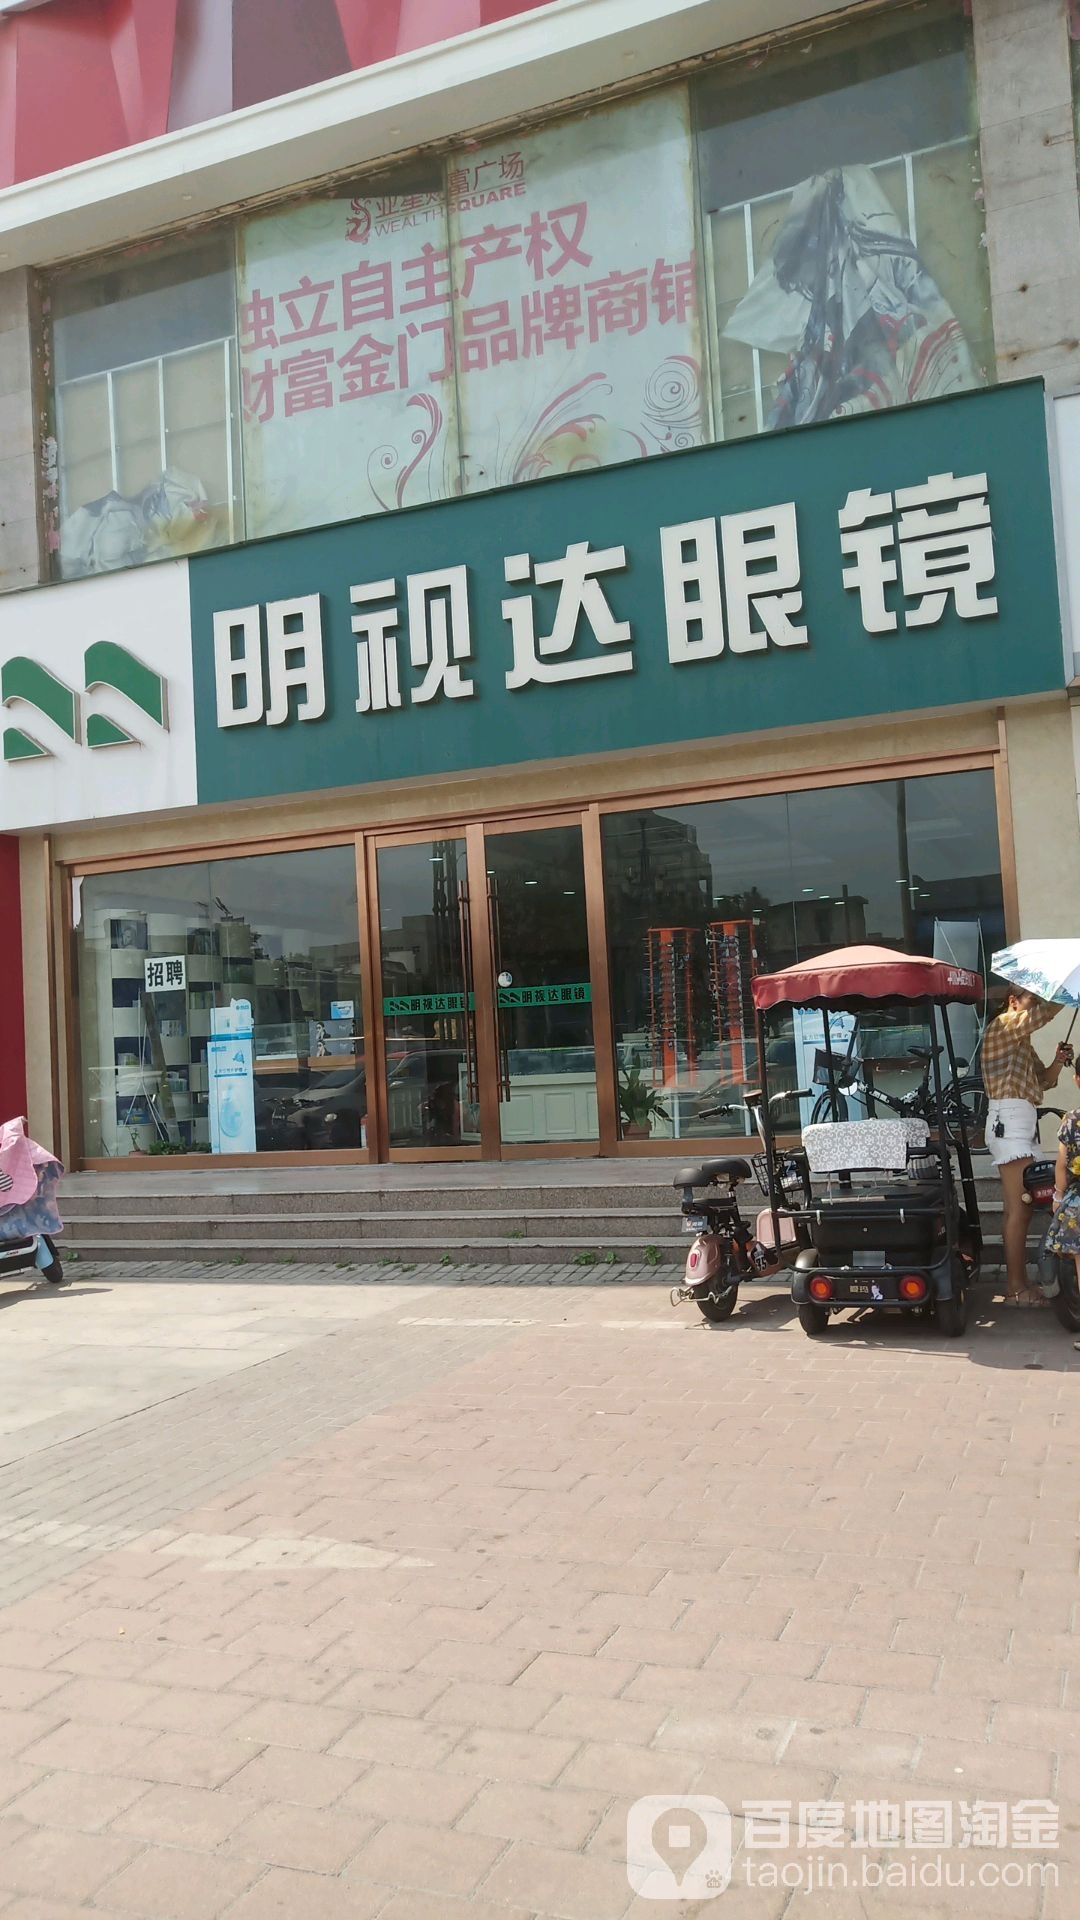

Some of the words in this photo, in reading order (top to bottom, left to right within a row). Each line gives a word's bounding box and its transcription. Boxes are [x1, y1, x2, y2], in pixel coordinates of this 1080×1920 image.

[375, 206, 444, 237] WEALTH
[213, 472, 1000, 728] 明视达眼镜
[146, 960, 185, 987] 招聘
[521, 987, 585, 1003] 明视达眼镜
